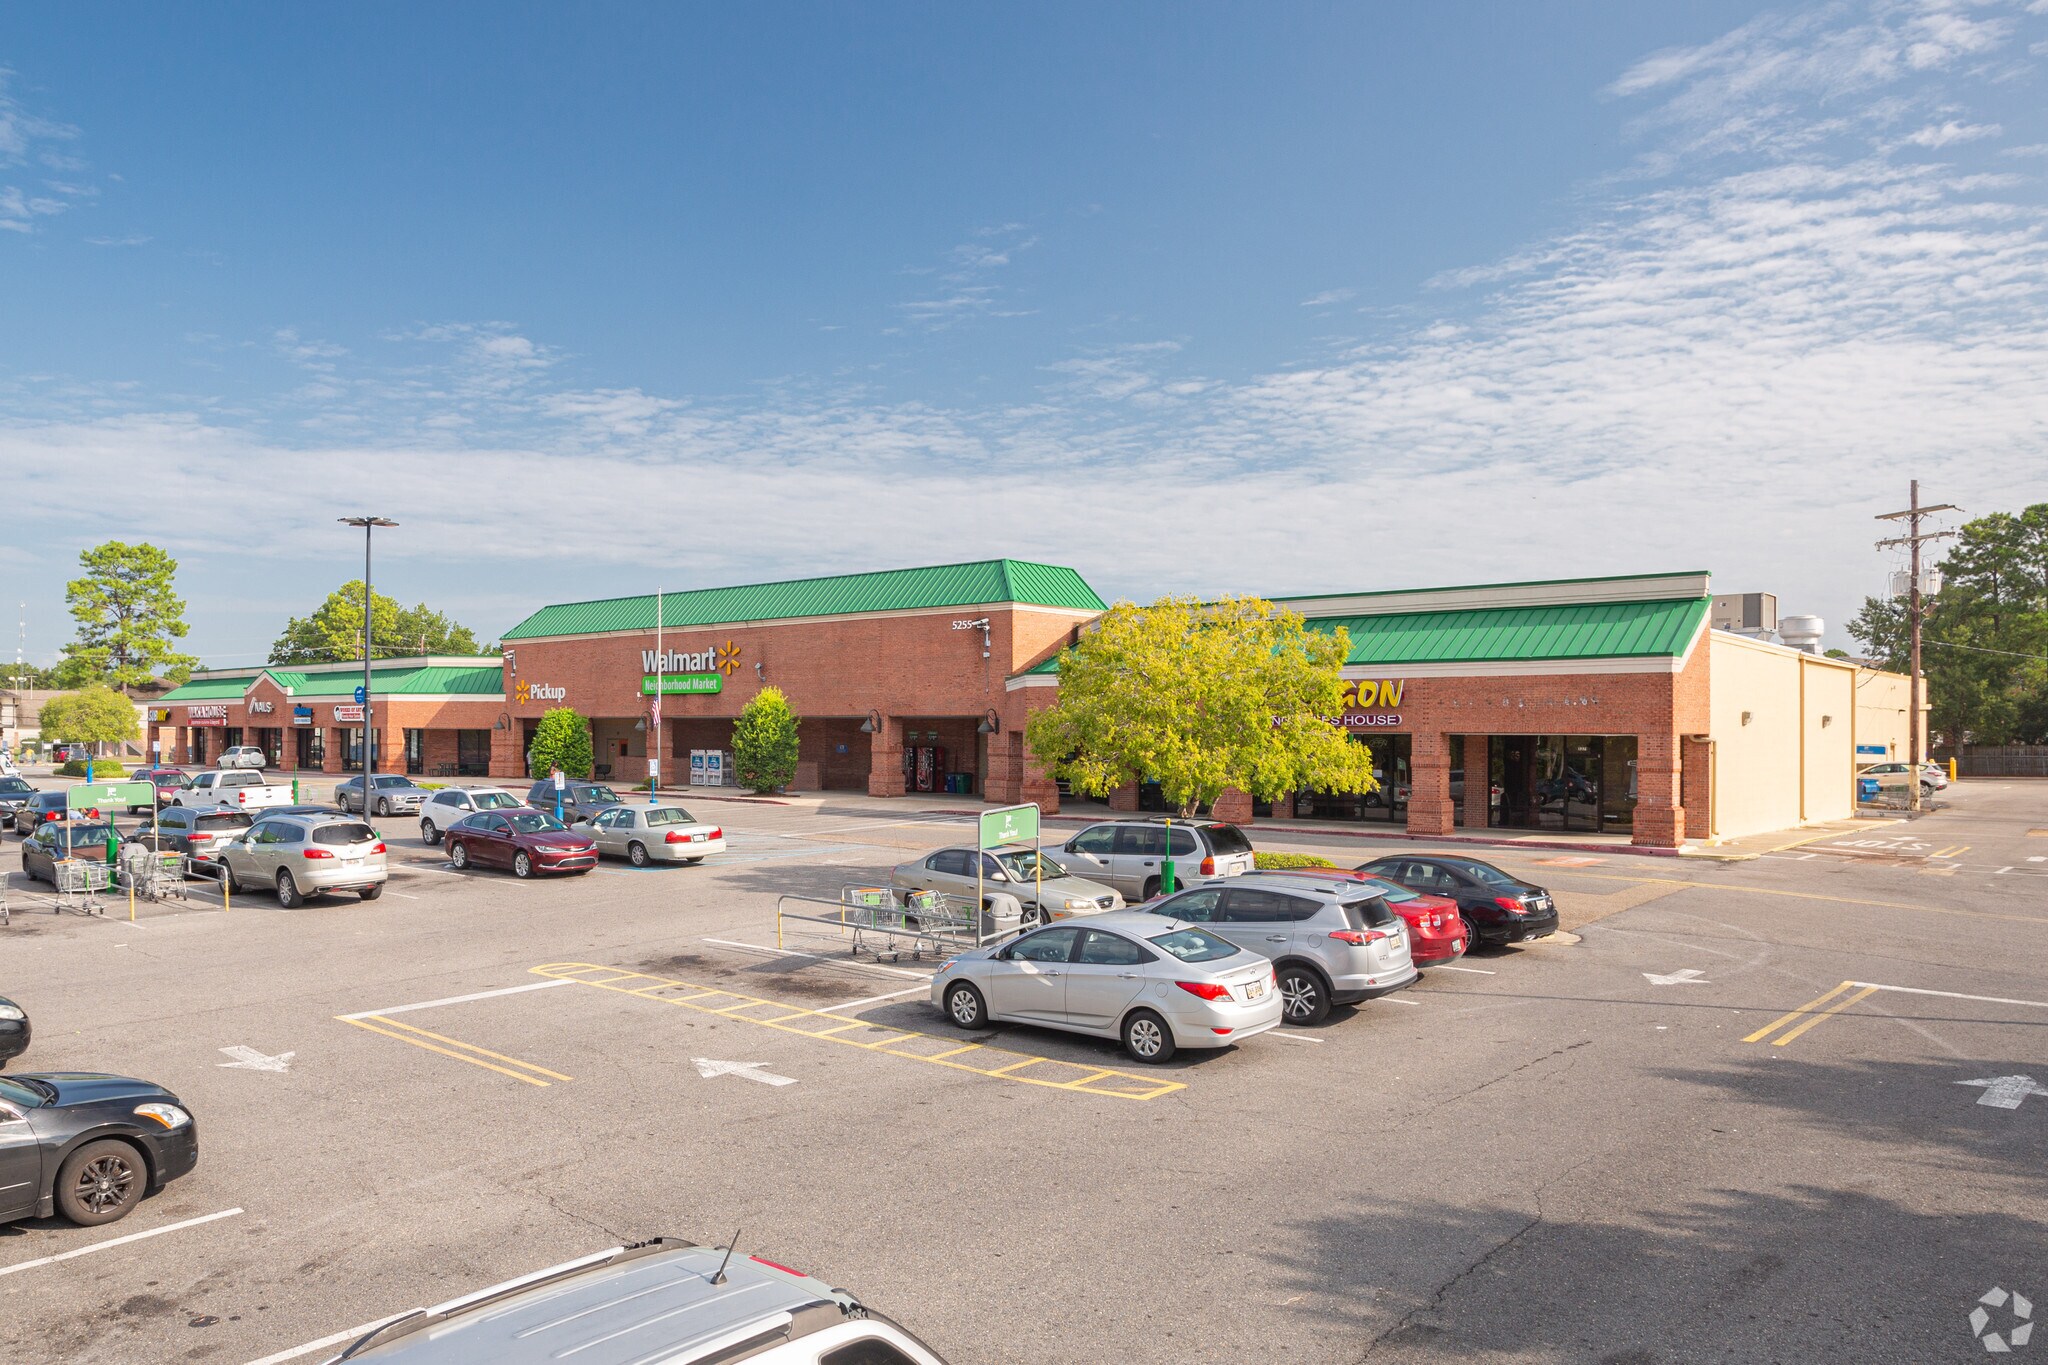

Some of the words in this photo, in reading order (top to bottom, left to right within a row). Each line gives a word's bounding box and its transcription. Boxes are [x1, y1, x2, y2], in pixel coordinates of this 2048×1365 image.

[952, 620, 972, 630] 5255
[641, 646, 716, 673] Walmart
[692, 678, 717, 690] Market
[530, 683, 566, 702] Pickup
[254, 701, 272, 713] NAILS
[148, 708, 170, 721] SUBWAY
[1832, 840, 1932, 850] STOP
